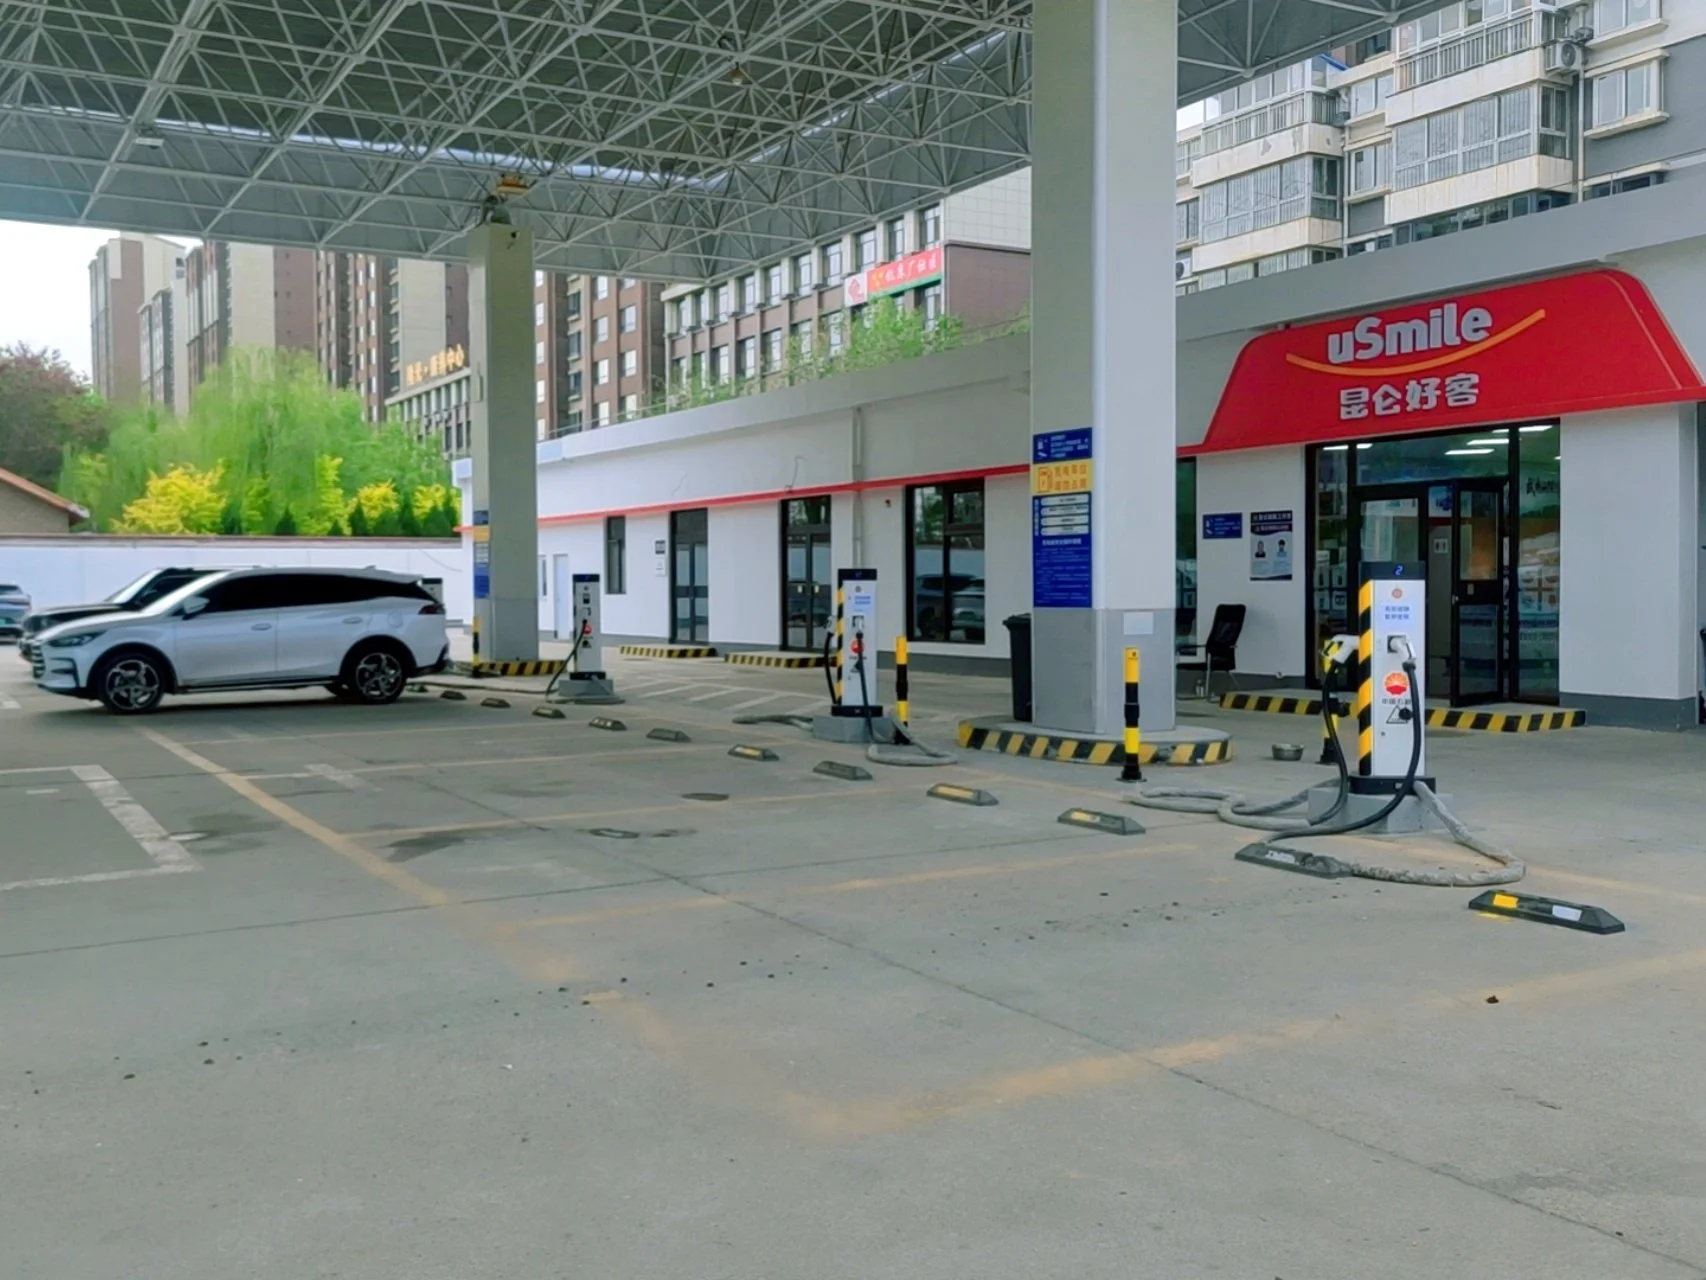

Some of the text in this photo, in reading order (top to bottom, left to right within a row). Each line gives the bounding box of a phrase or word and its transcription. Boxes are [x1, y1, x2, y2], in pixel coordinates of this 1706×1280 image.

[1328, 302, 1493, 364] uSmile
[1339, 372, 1480, 420] 昆仑好客
[1395, 564, 1404, 576] 2
